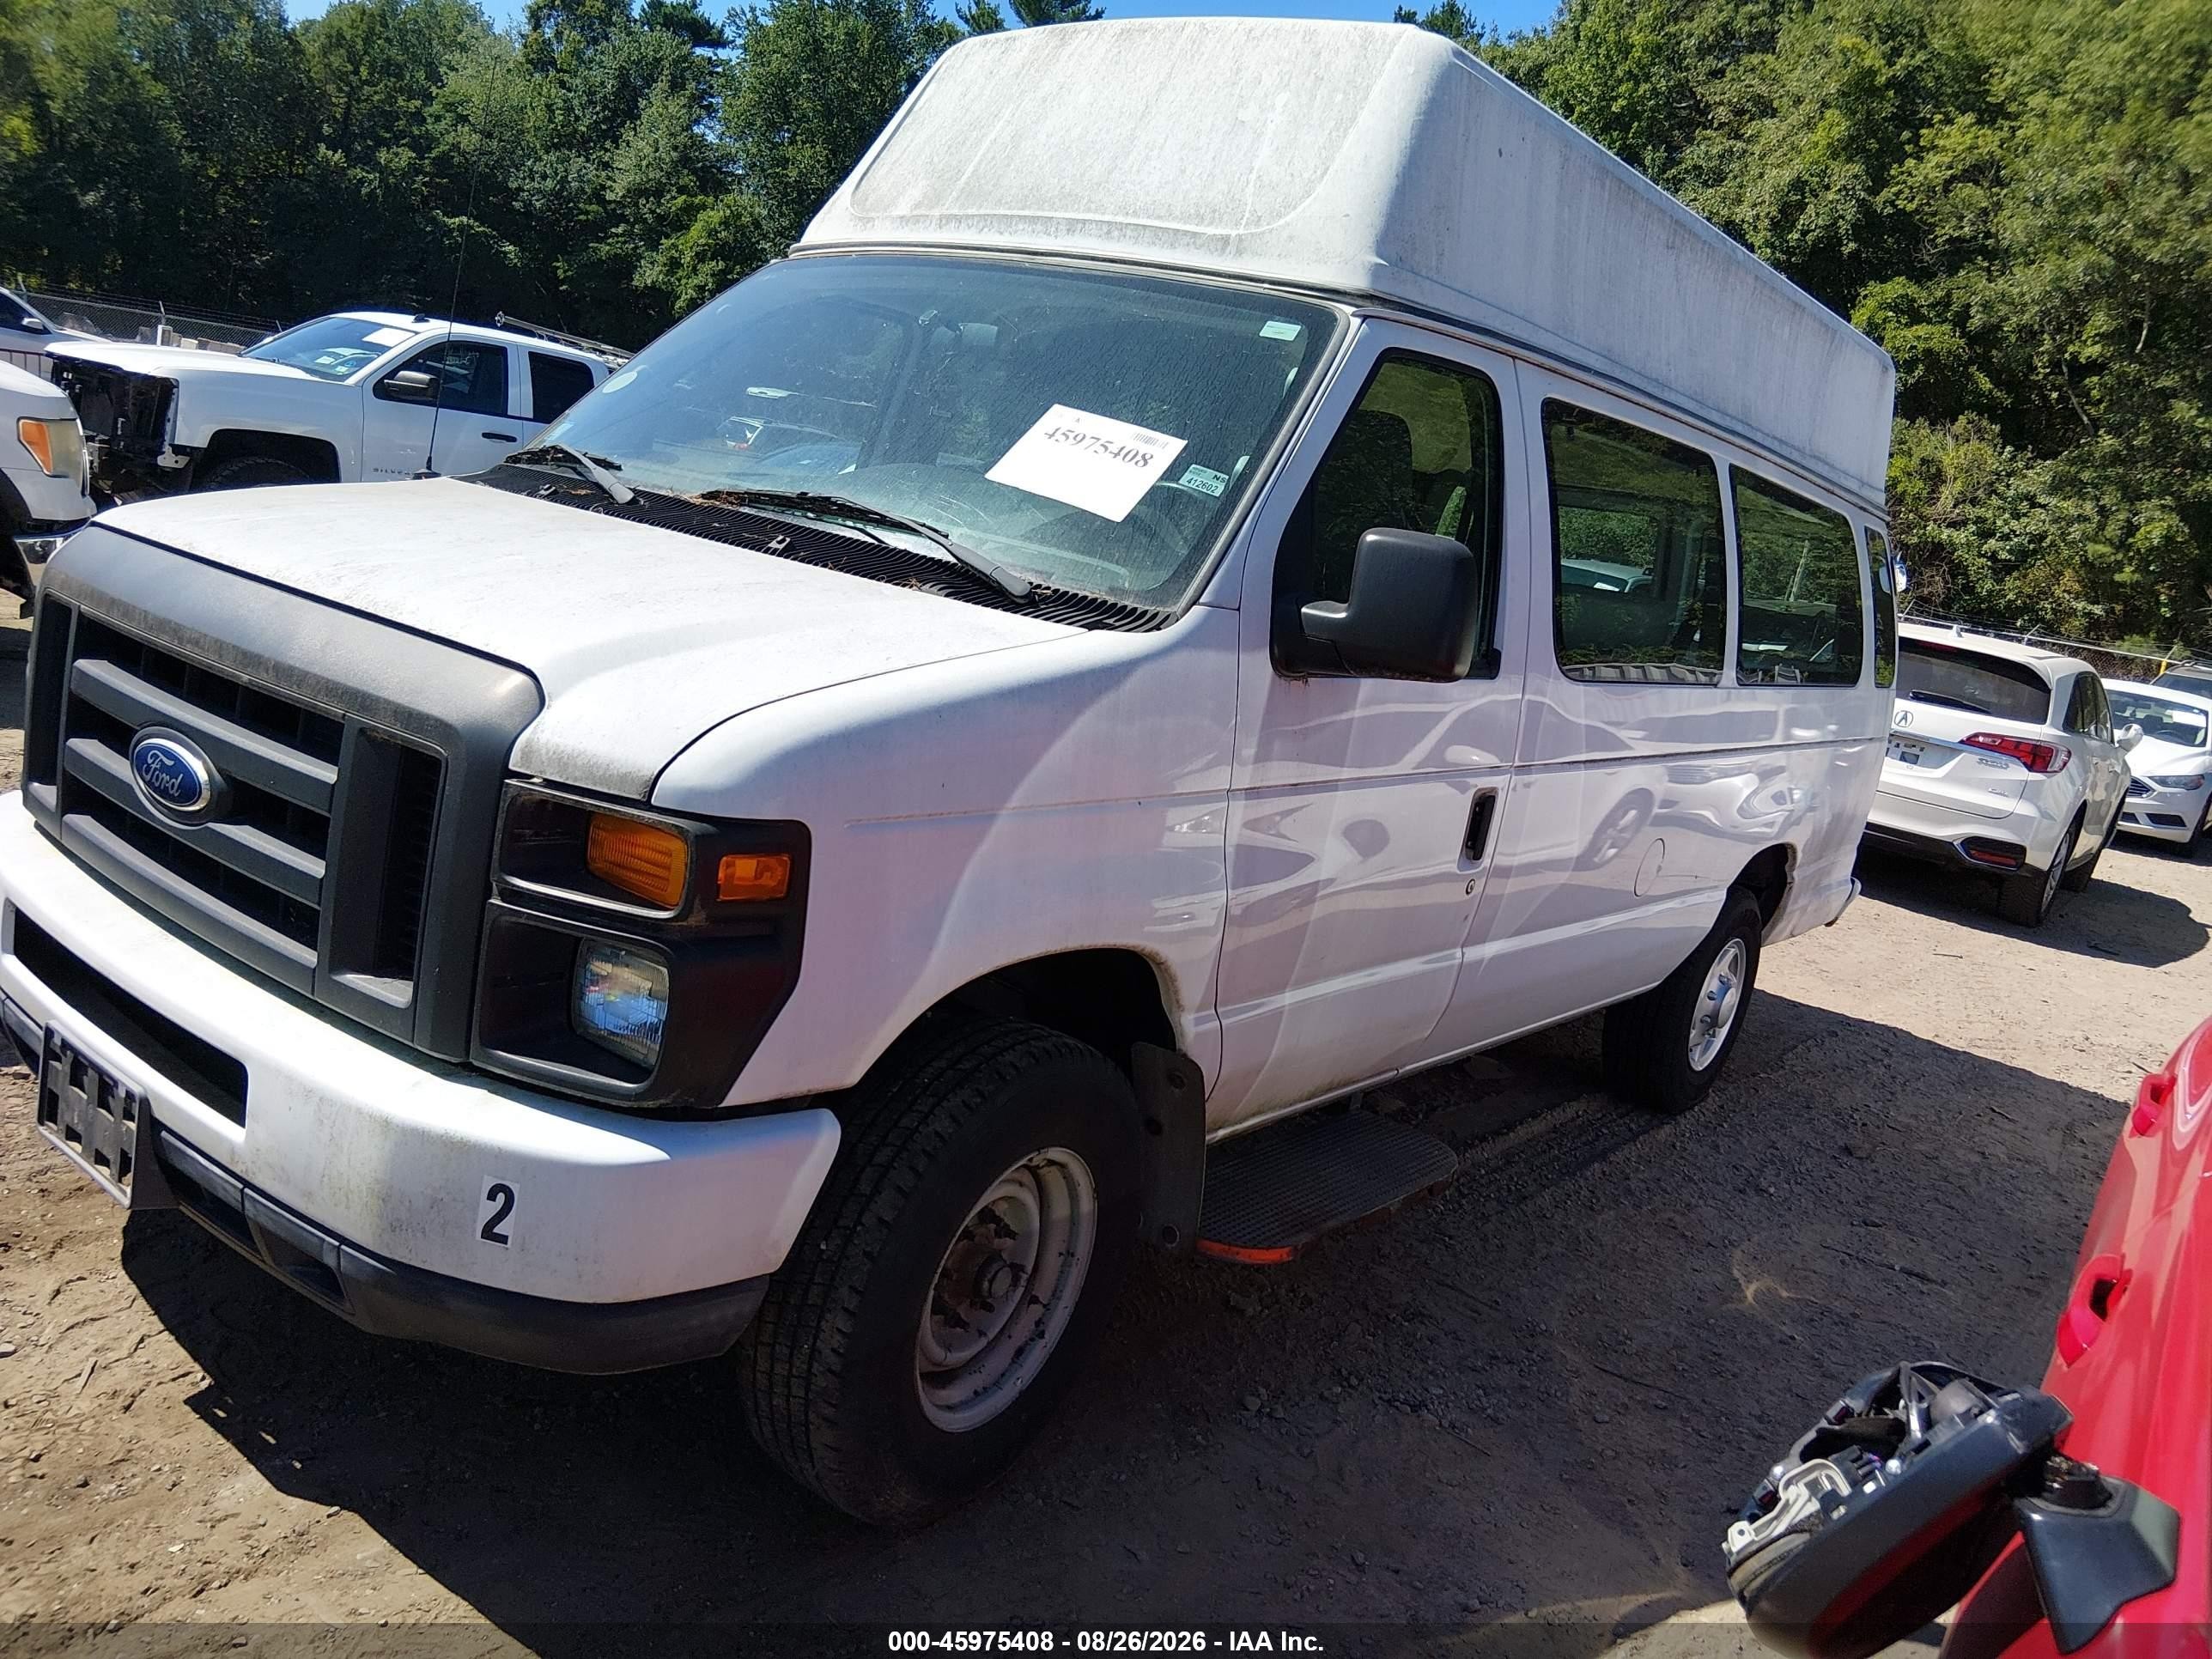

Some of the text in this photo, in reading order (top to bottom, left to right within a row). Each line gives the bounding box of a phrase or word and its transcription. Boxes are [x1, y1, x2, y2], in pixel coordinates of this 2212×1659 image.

[1043, 426, 1154, 468] 45975408
[1186, 477, 1218, 494] 412602
[142, 750, 184, 797] Ford
[480, 1182, 515, 1245] 2
